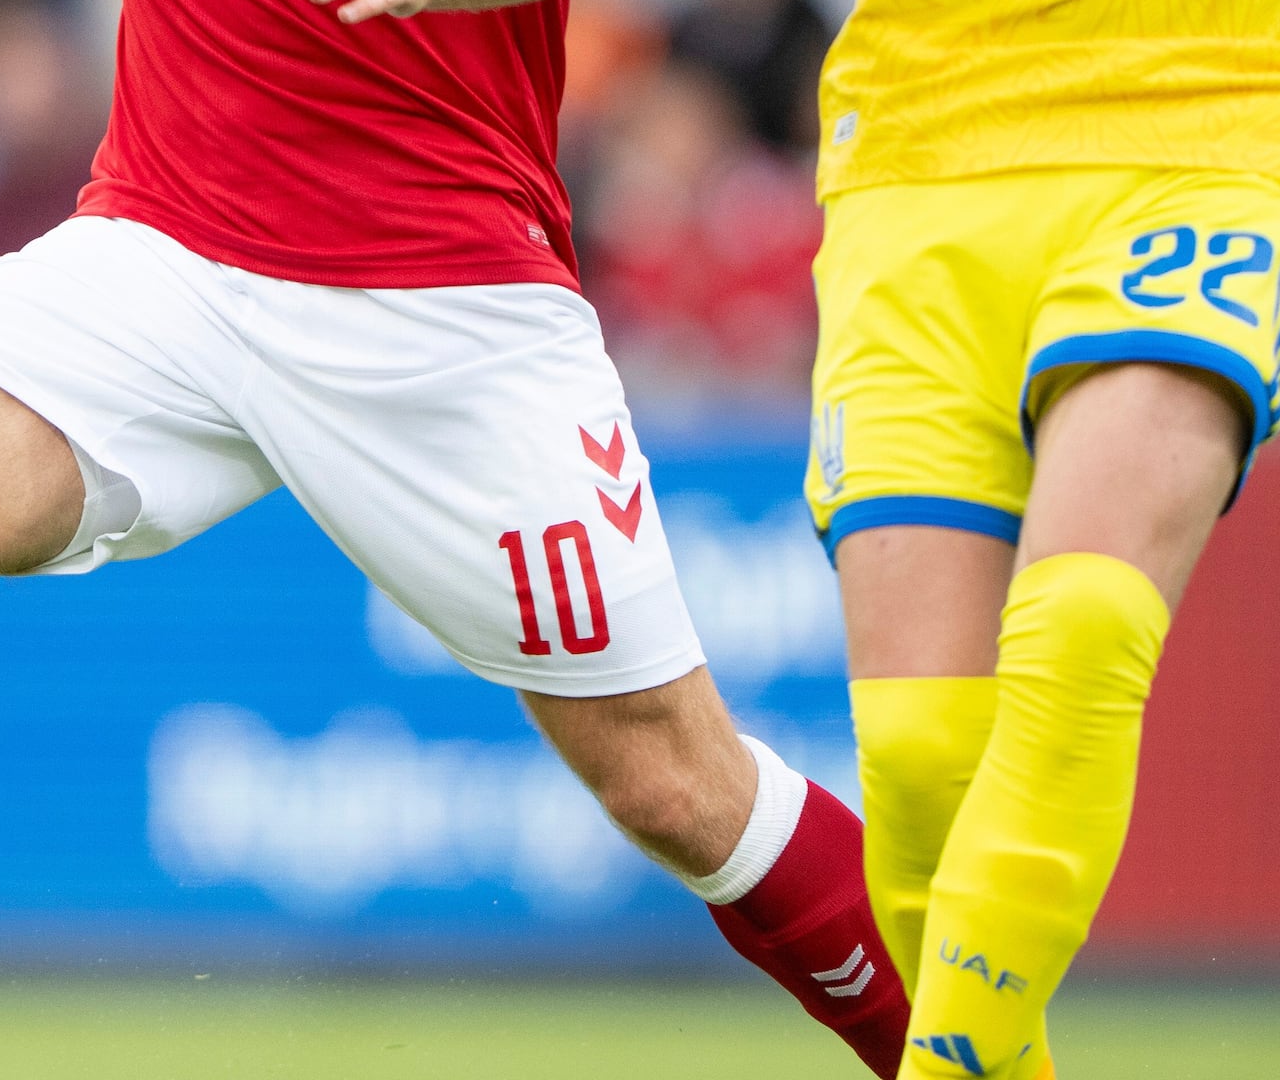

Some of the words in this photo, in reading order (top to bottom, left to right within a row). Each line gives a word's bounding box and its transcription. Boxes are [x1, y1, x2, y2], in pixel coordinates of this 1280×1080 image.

[1121, 225, 1274, 328] 22
[498, 520, 610, 656] 10
[939, 937, 1029, 993] UAF
